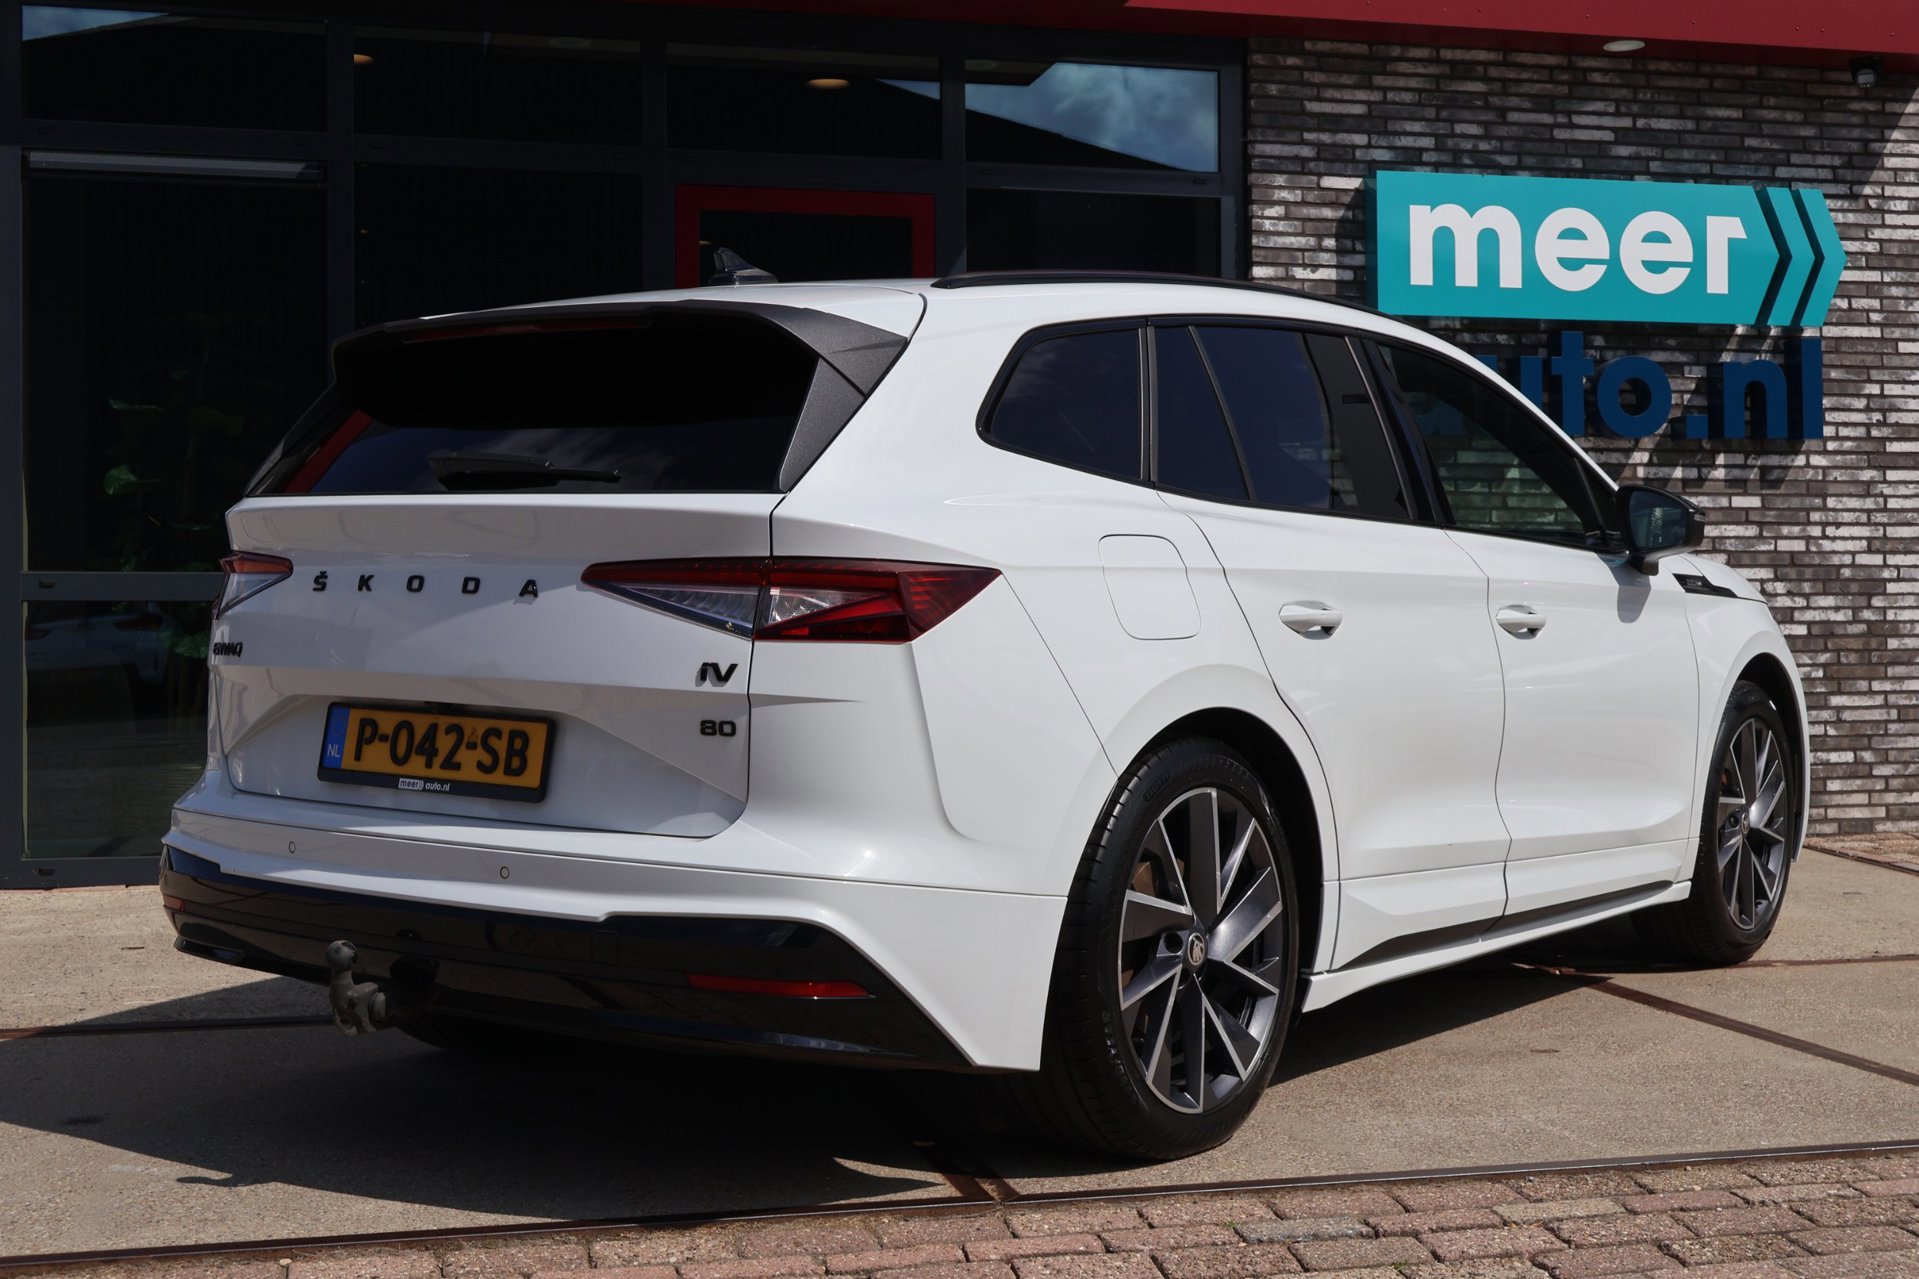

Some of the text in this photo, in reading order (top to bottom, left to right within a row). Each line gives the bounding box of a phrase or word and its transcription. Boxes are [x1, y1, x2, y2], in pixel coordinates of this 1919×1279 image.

[1409, 203, 1748, 295] meer
[313, 571, 539, 598] ŠKODA
[699, 719, 736, 737] 80
[327, 718, 529, 776] NL P-042-SB
[425, 782, 450, 791] auto.nl
